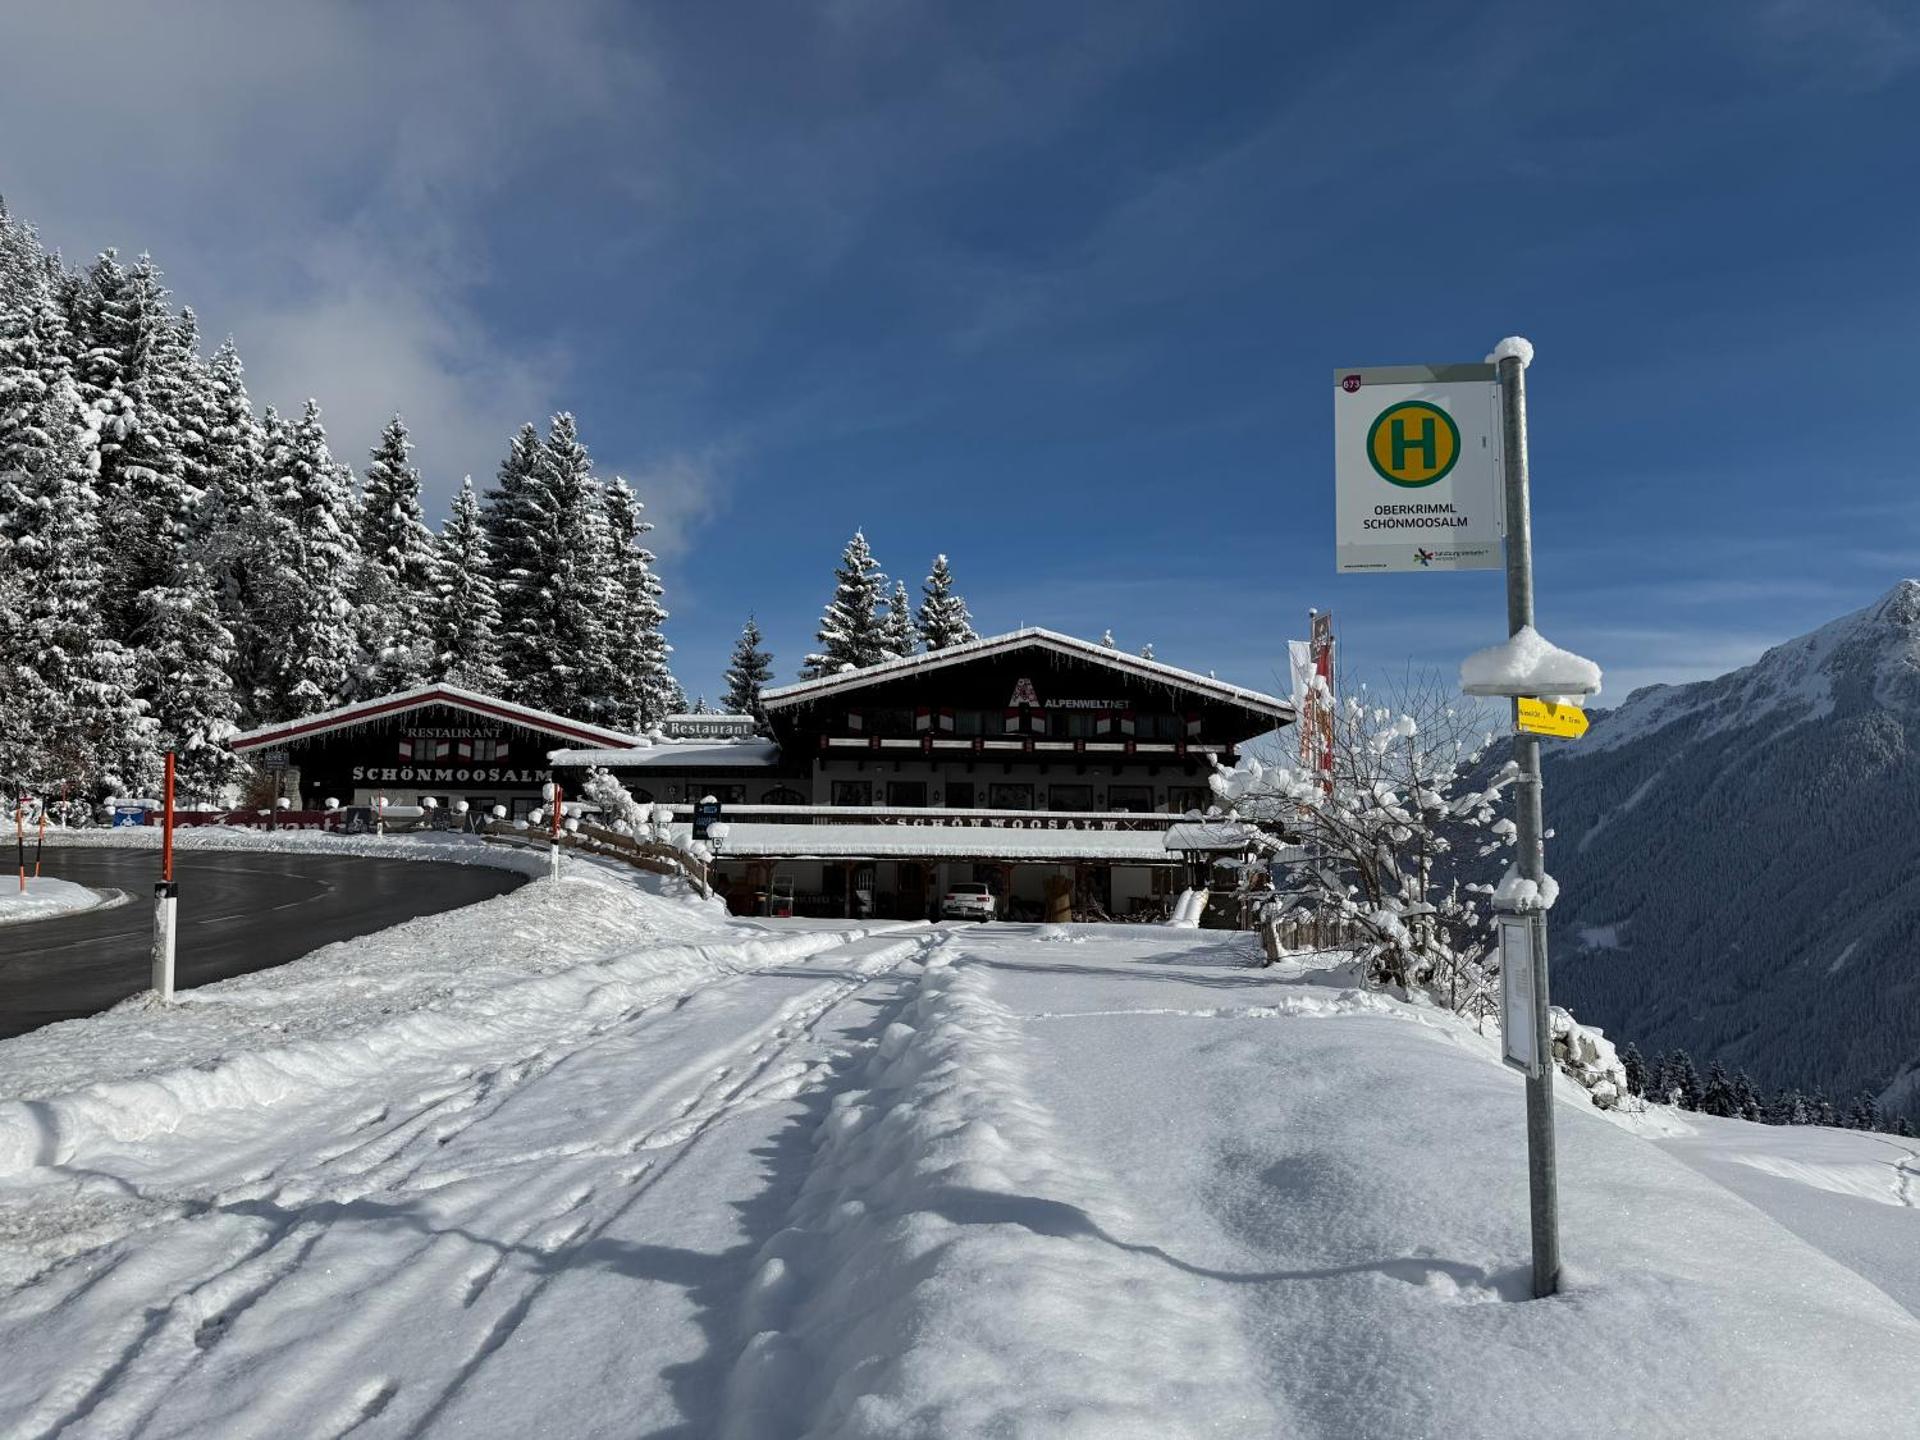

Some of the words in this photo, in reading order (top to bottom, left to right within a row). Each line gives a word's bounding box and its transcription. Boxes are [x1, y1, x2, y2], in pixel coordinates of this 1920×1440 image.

[1391, 418, 1436, 470] H
[1374, 503, 1457, 516] OBERKRIMML
[1363, 516, 1468, 530] SCHÖNMOOSALM
[407, 727, 501, 738] RESTAURANT
[671, 722, 749, 734] Restaurant
[353, 765, 554, 782] SCHÖNMOOSALM
